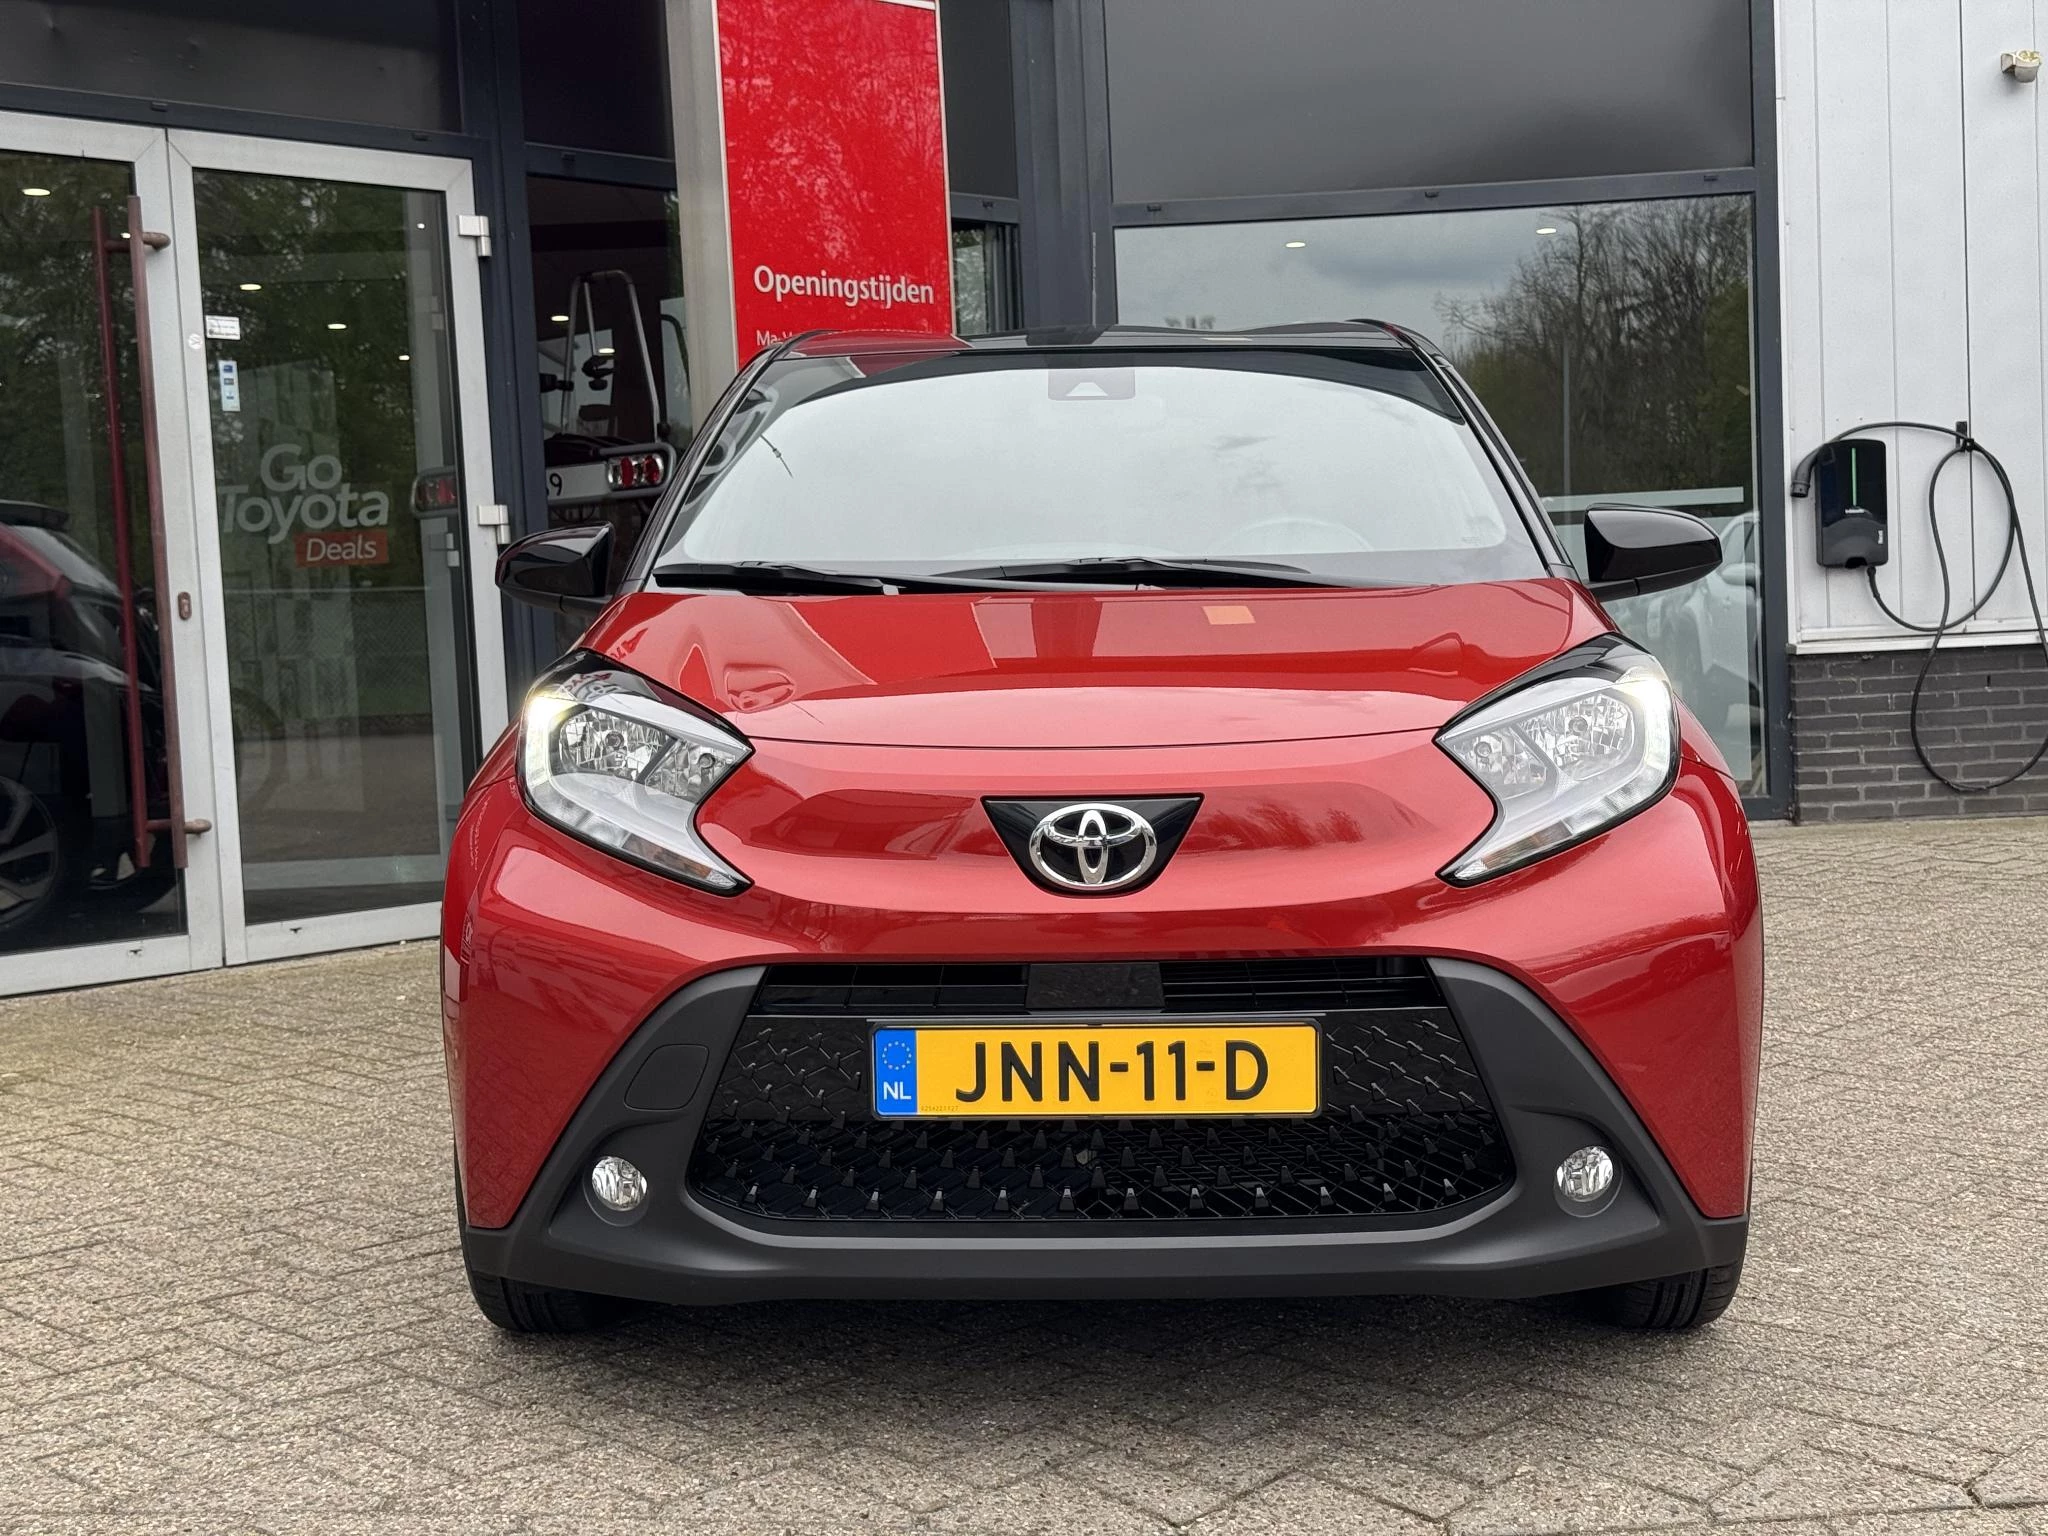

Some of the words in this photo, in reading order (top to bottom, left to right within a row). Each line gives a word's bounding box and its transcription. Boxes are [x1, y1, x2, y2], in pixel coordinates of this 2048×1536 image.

[753, 265, 935, 310] Openingstijden
[260, 443, 343, 492] Go
[217, 482, 389, 544] Toyota
[306, 534, 377, 562] Deals
[883, 1081, 912, 1100] NL
[956, 1039, 1268, 1102] JNN-11-D
